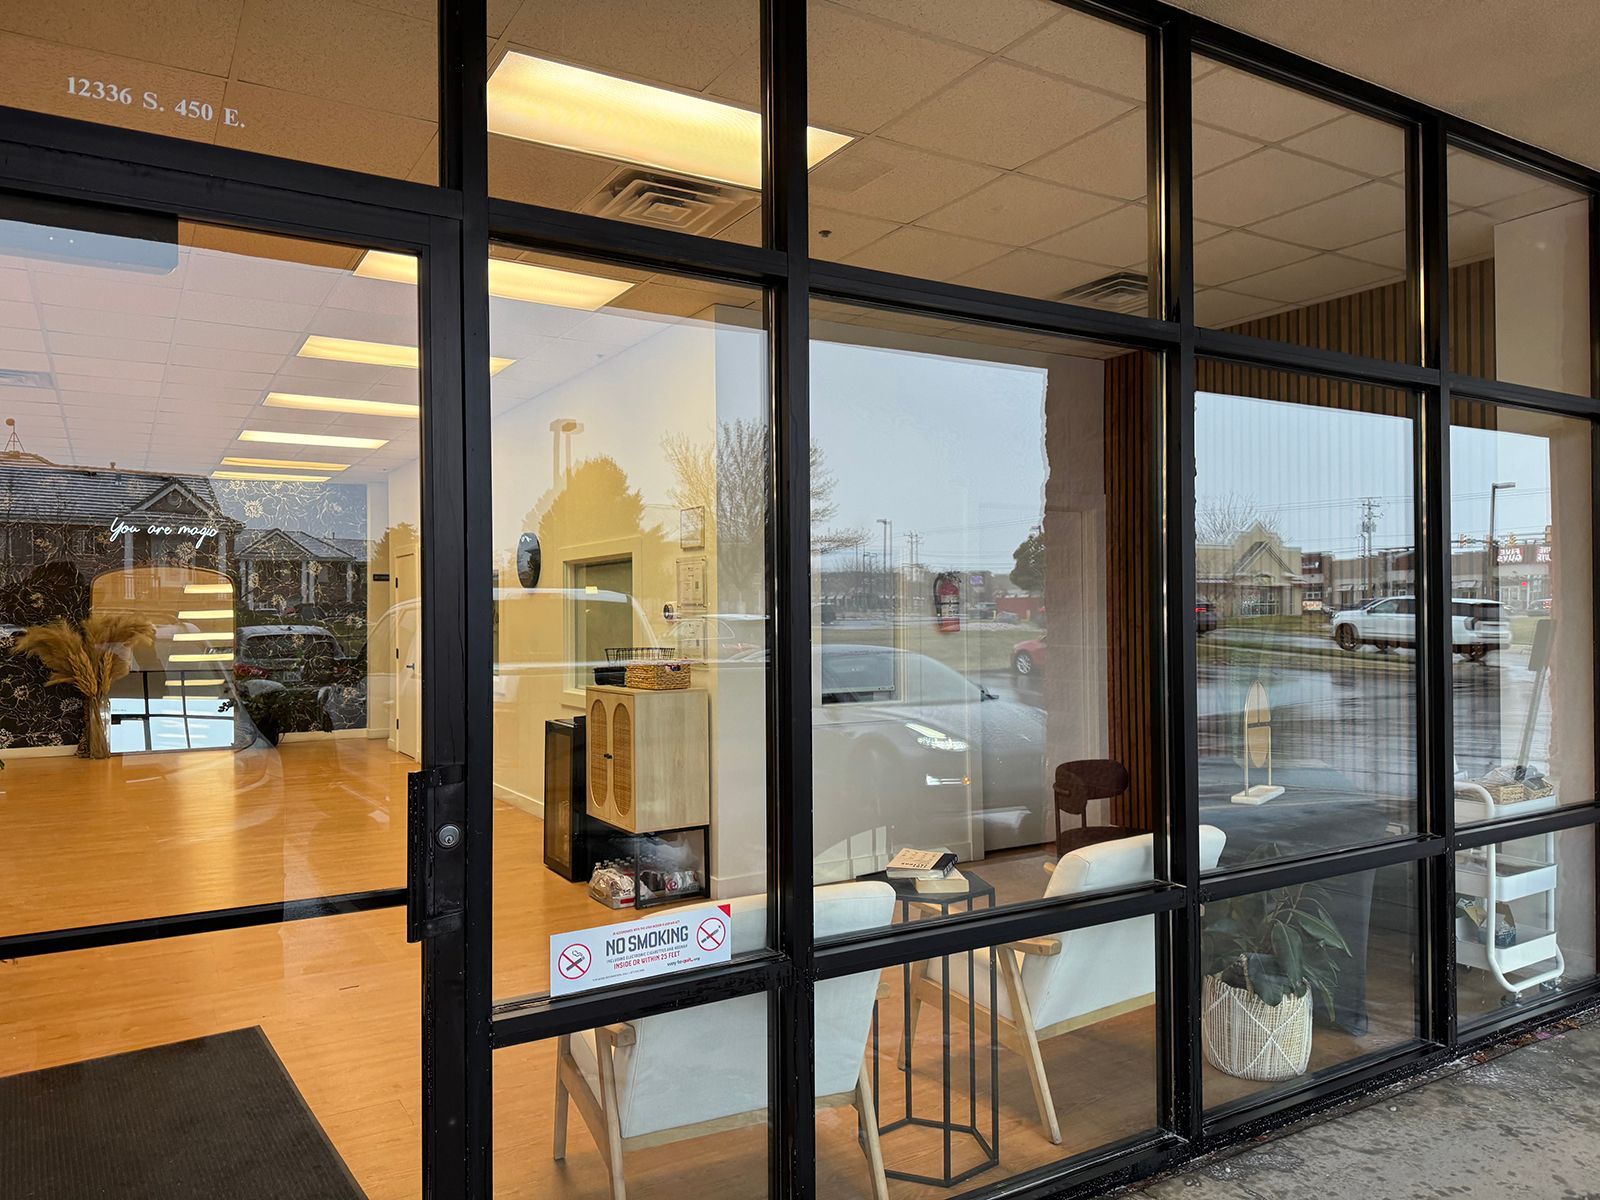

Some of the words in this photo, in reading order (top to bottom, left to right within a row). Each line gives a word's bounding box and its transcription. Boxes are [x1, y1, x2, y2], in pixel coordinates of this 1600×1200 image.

[67, 76, 132, 105] 12336
[143, 92, 165, 112] S.
[174, 99, 213, 121] 450
[223, 107, 246, 128] E.
[109, 517, 141, 542] You
[147, 525, 172, 535] are
[177, 525, 219, 549] magic
[606, 937, 625, 956] NO
[628, 925, 689, 952] SMOKING
[613, 960, 632, 970] INSIDE
[633, 958, 641, 966] OR
[641, 955, 660, 964] WITHIN
[668, 950, 681, 958] FEET
